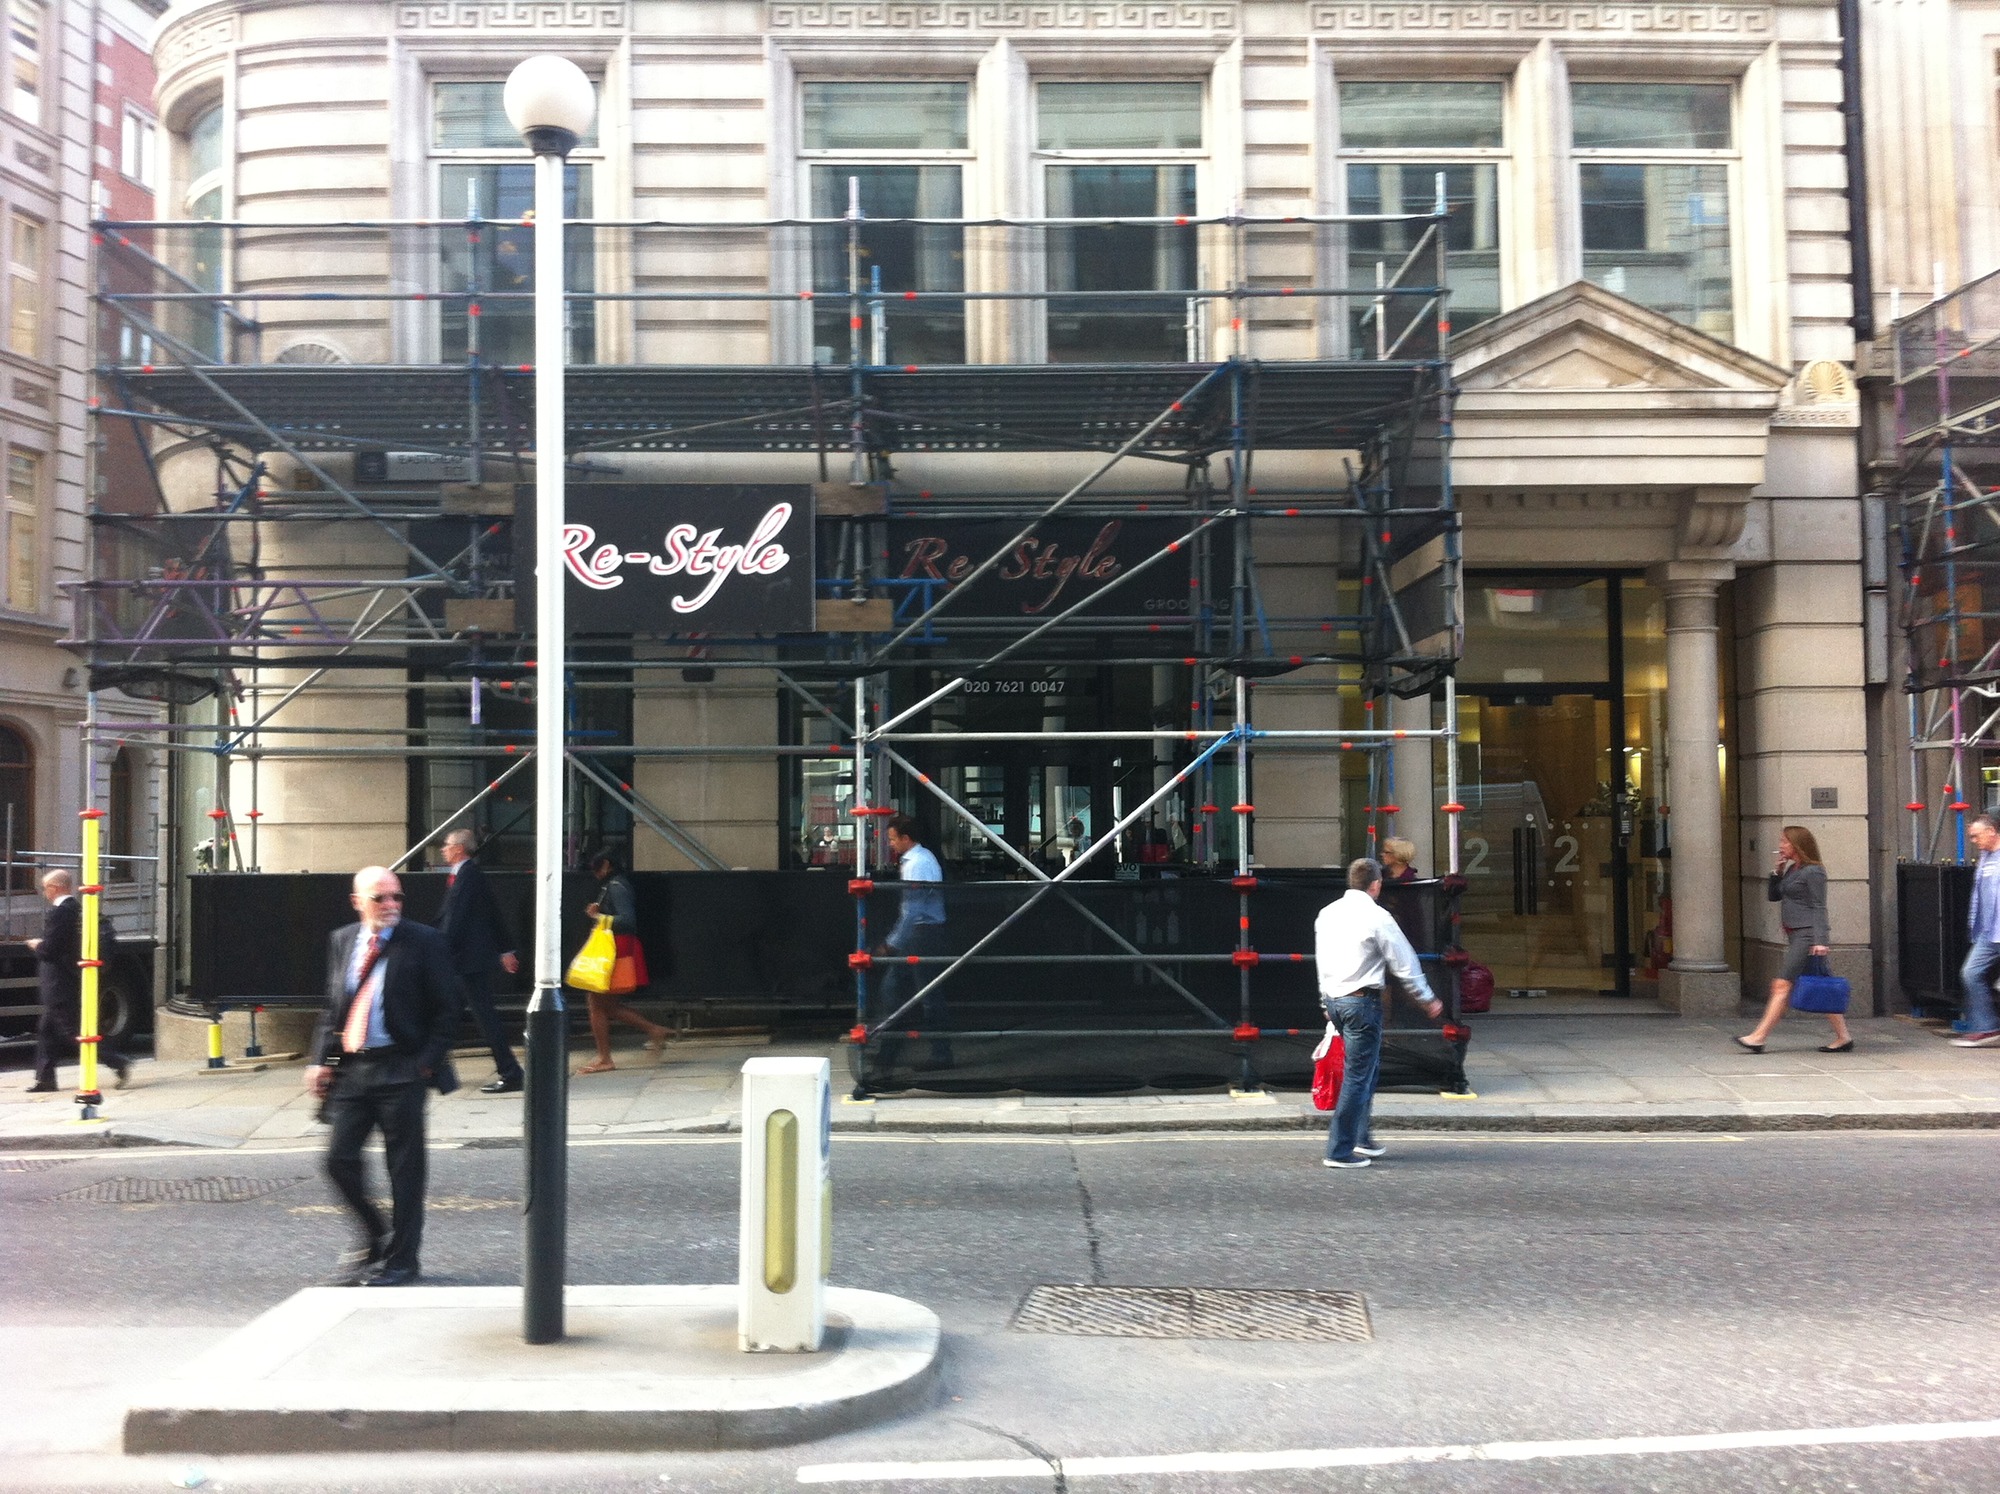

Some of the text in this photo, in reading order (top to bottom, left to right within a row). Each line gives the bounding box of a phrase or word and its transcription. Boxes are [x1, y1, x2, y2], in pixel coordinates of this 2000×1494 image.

[562, 501, 793, 613] Re-Style
[902, 518, 1124, 614] ReStyle
[1143, 598, 1231, 611] GROONG
[964, 681, 1065, 693] 020 7621 0047
[1464, 835, 1580, 875] 2 2
